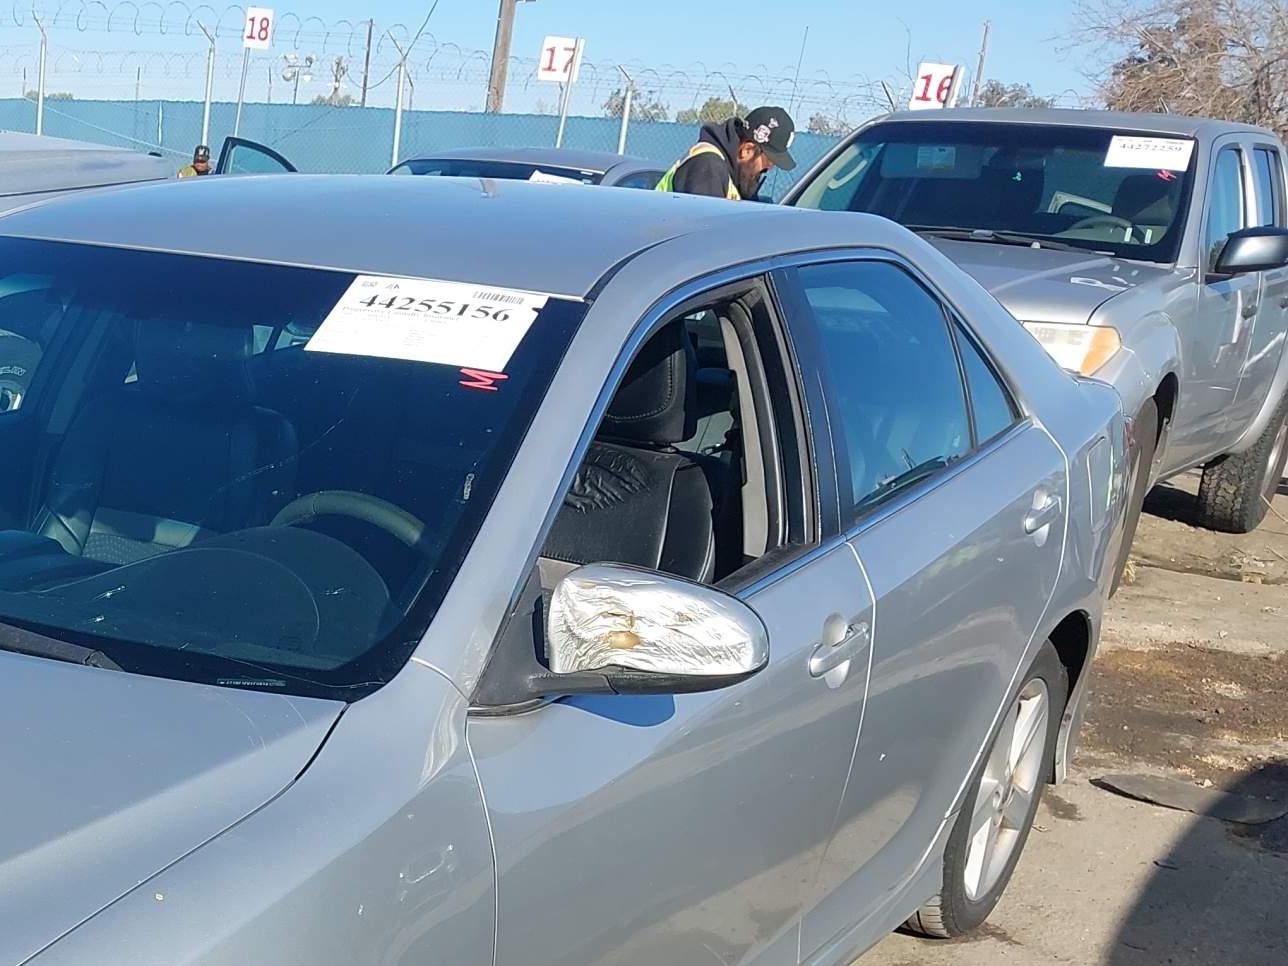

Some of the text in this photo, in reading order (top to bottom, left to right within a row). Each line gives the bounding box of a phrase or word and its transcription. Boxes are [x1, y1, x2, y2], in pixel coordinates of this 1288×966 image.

[246, 16, 270, 41] 18
[542, 46, 576, 73] 17
[915, 73, 953, 103] 16
[359, 293, 513, 322] 44255156
